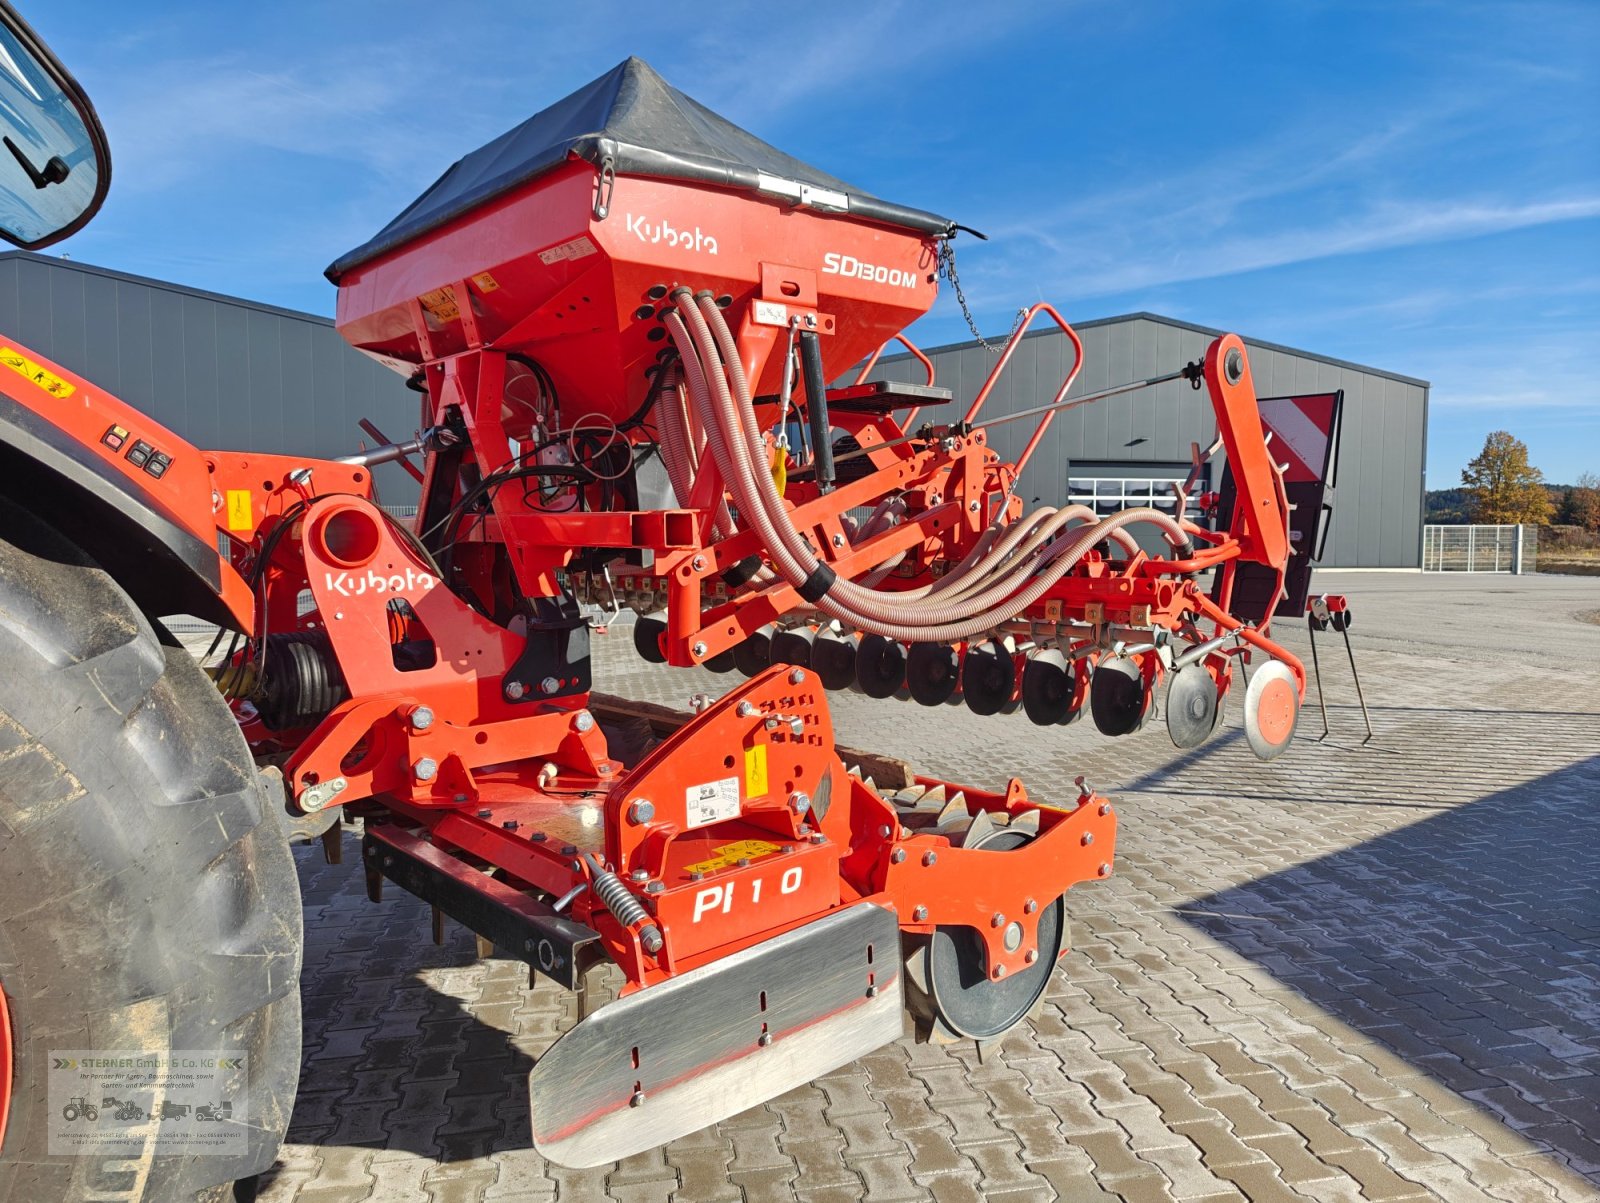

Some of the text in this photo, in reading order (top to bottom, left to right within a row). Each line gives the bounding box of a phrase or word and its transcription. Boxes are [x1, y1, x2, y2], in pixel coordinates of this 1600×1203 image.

[626, 213, 718, 255] Kubota
[822, 252, 917, 289] SD1300M
[325, 568, 435, 597] Kubota
